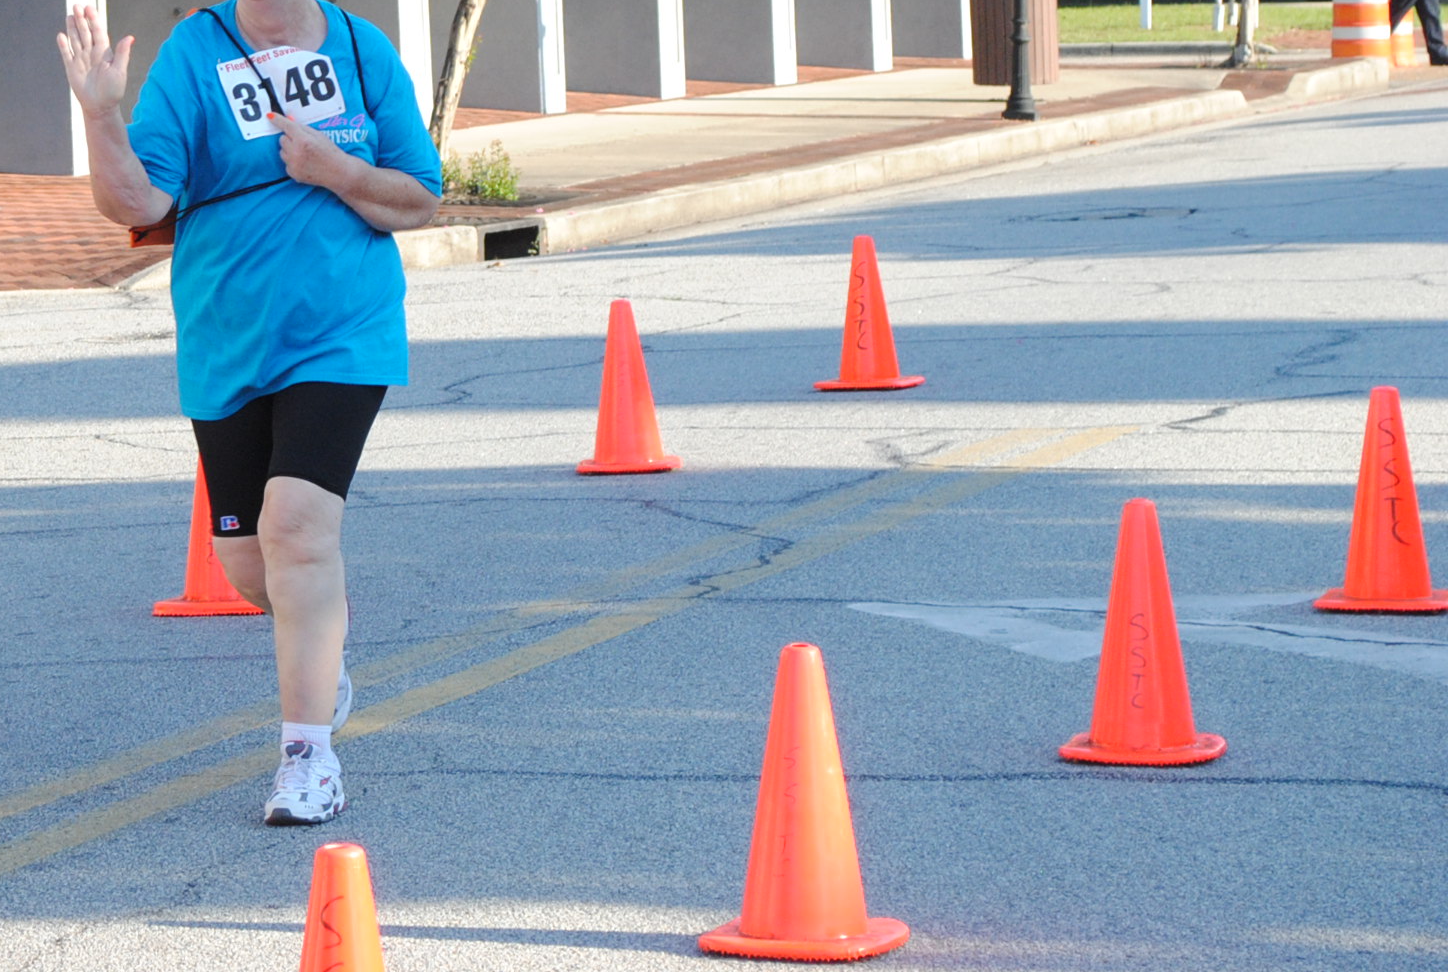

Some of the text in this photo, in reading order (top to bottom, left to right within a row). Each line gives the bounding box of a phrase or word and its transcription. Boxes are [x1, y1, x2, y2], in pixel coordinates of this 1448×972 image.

[232, 59, 336, 122] 3148
[1378, 417, 1410, 546] SSTC
[1130, 613, 1150, 709] SSTC
